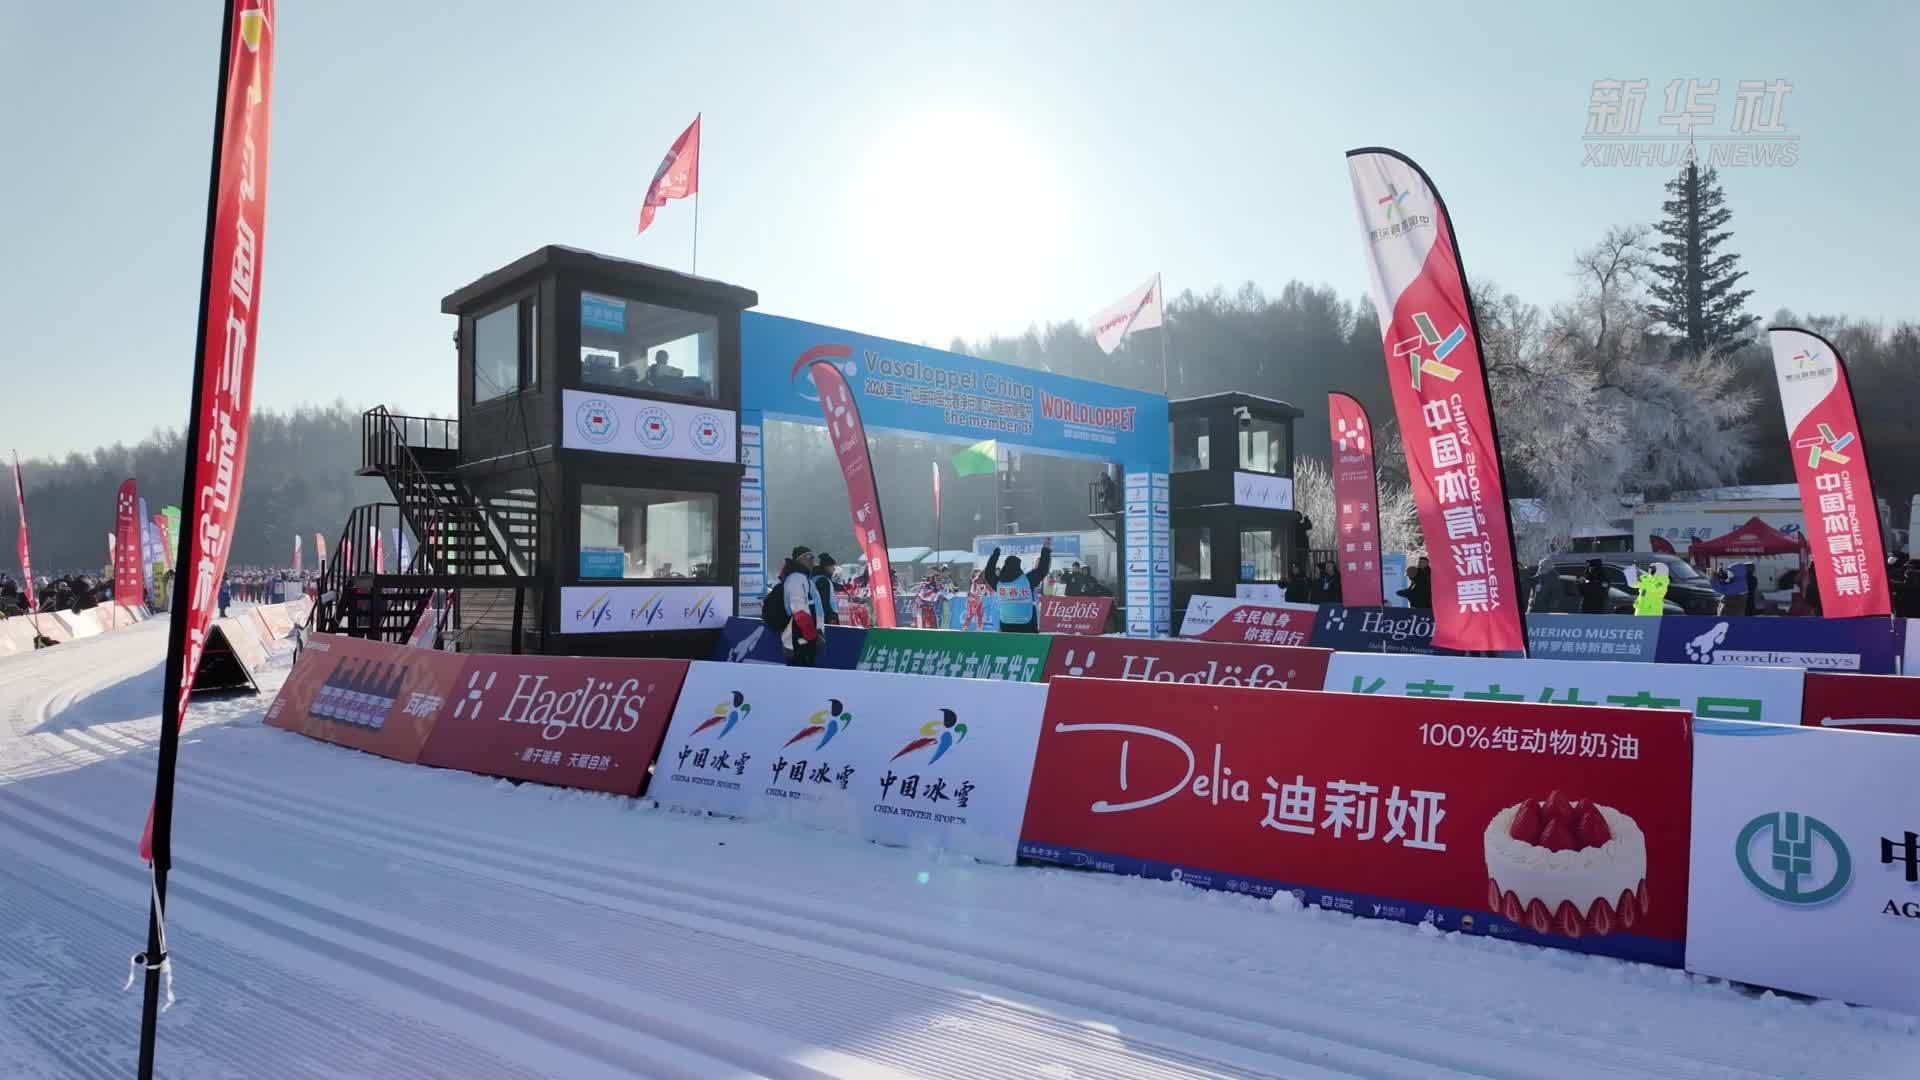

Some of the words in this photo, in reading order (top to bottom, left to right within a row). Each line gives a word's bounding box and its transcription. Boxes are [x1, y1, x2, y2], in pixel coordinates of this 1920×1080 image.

[865, 350, 978, 391] Vasaloppet
[984, 370, 1033, 400] China
[944, 409, 966, 427] the
[970, 414, 1020, 432] member
[1040, 391, 1137, 433] WORLDLOPPET
[1044, 600, 1100, 622] Haglöfs
[1232, 608, 1291, 628] 全民健身
[1243, 627, 1305, 646] 你我同行
[1528, 627, 1582, 639] MERINO
[1585, 628, 1645, 640] MUSTER
[1721, 653, 1792, 665] nordic
[1799, 657, 1855, 668] ways
[499, 673, 647, 741] Haglöfs
[1418, 722, 1640, 761] 100%纯动物奶油
[677, 744, 752, 775] 中国冰雪
[1055, 722, 1250, 814] Delia
[670, 773, 690, 784] CHINA
[772, 757, 856, 790] 中国冰雪
[765, 787, 787, 798] CHINA
[879, 769, 976, 808] 中国冰雪
[873, 804, 899, 815] CHINA
[900, 808, 933, 820] WINTER
[1261, 775, 1447, 852] 迪莉娅
